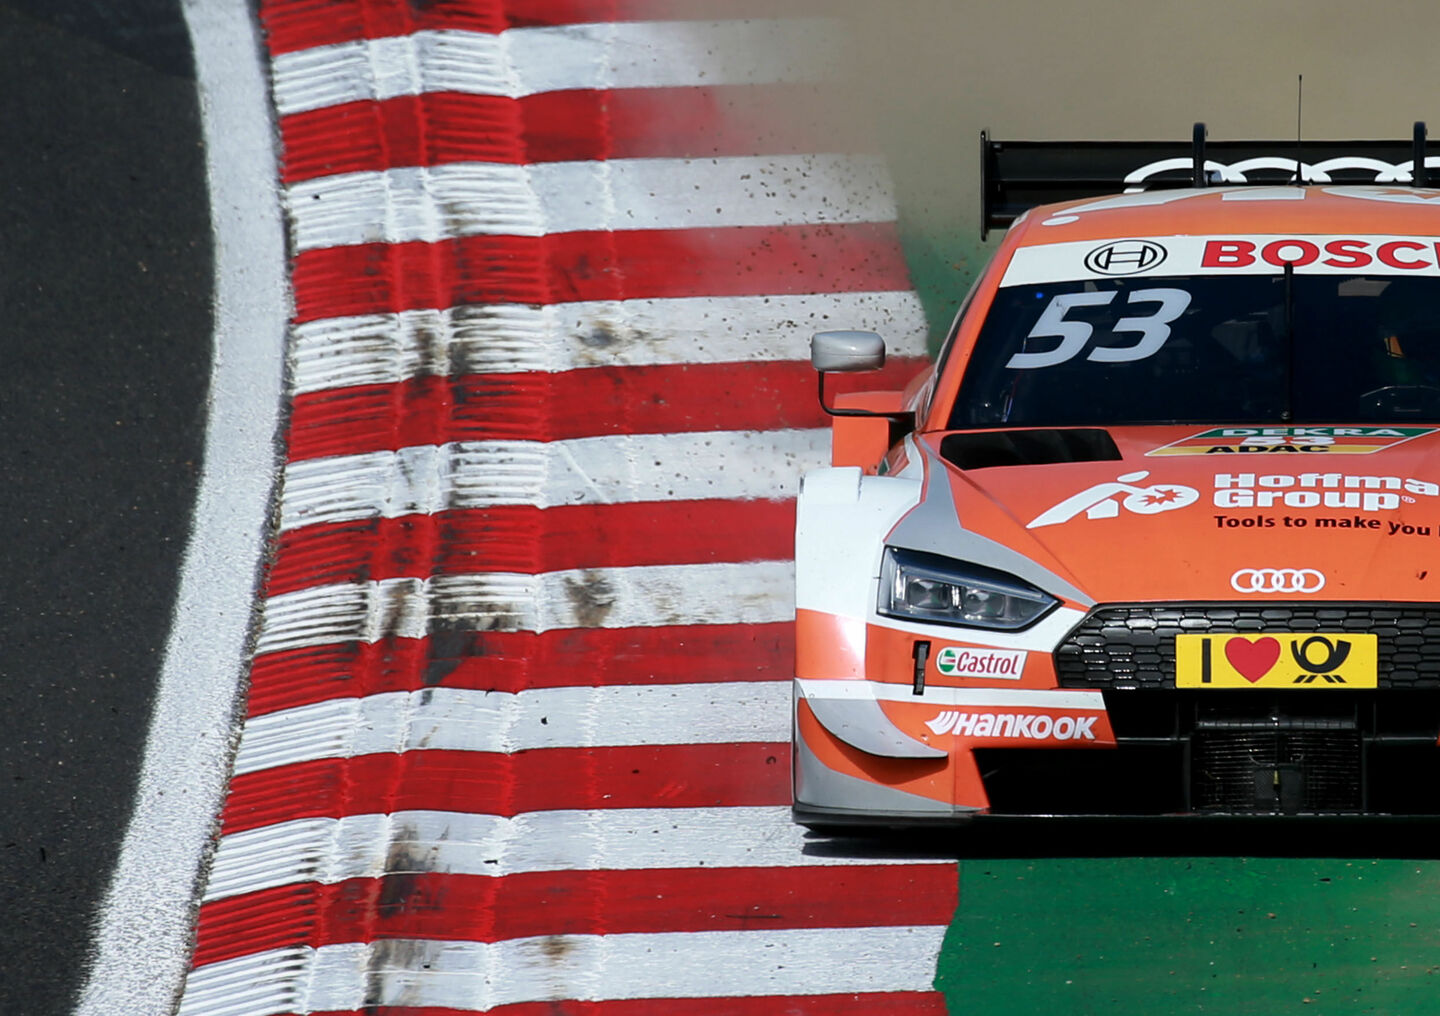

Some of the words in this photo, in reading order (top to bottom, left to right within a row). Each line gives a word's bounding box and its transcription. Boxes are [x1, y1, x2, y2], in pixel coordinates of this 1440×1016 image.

[1005, 288, 1192, 369] 53
[1222, 427, 1406, 437] DEKRA
[1240, 436, 1336, 446] 53
[1206, 445, 1330, 454] ADAC
[1214, 515, 1276, 528] Tools
[1283, 516, 1308, 528] to
[1315, 516, 1382, 530] make
[1388, 520, 1431, 536] you
[956, 651, 1020, 675] Castrol
[1202, 638, 1211, 683] I
